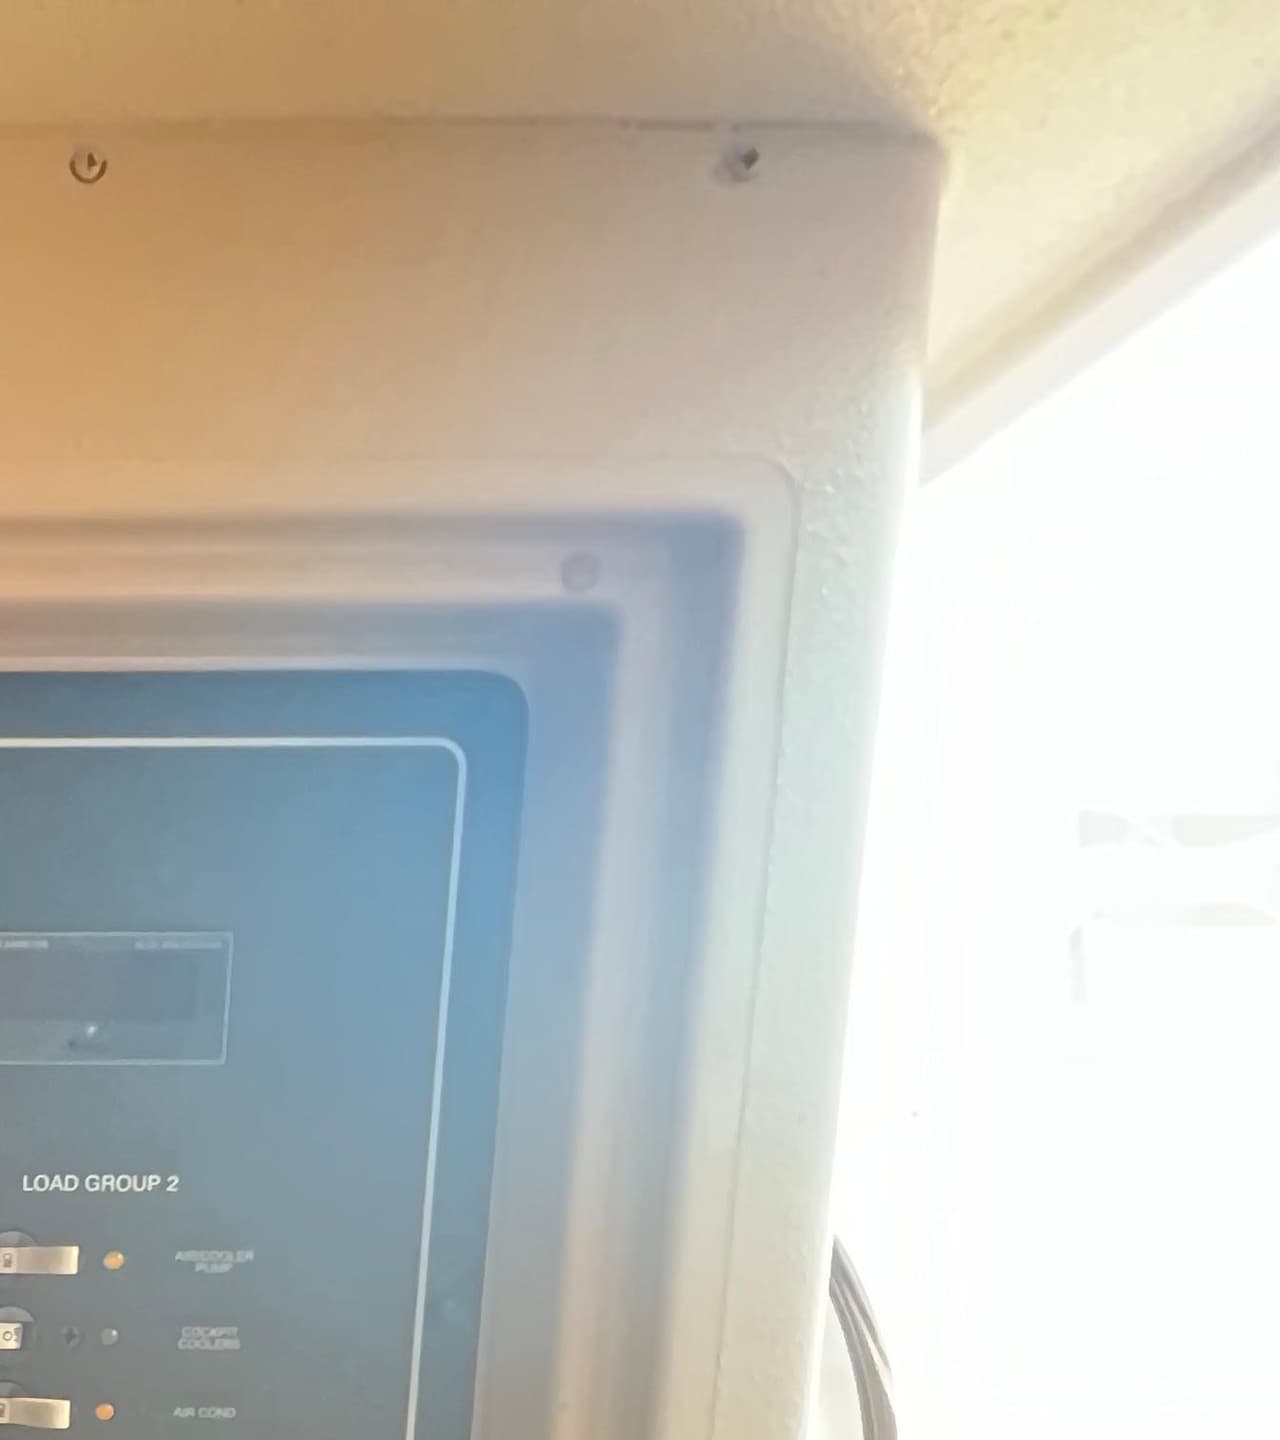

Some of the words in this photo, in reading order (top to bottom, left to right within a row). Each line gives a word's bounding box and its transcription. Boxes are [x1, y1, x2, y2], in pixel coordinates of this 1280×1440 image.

[22, 1174, 78, 1192] LOAD
[85, 1174, 161, 1192] GROUP
[167, 1176, 179, 1192] 2
